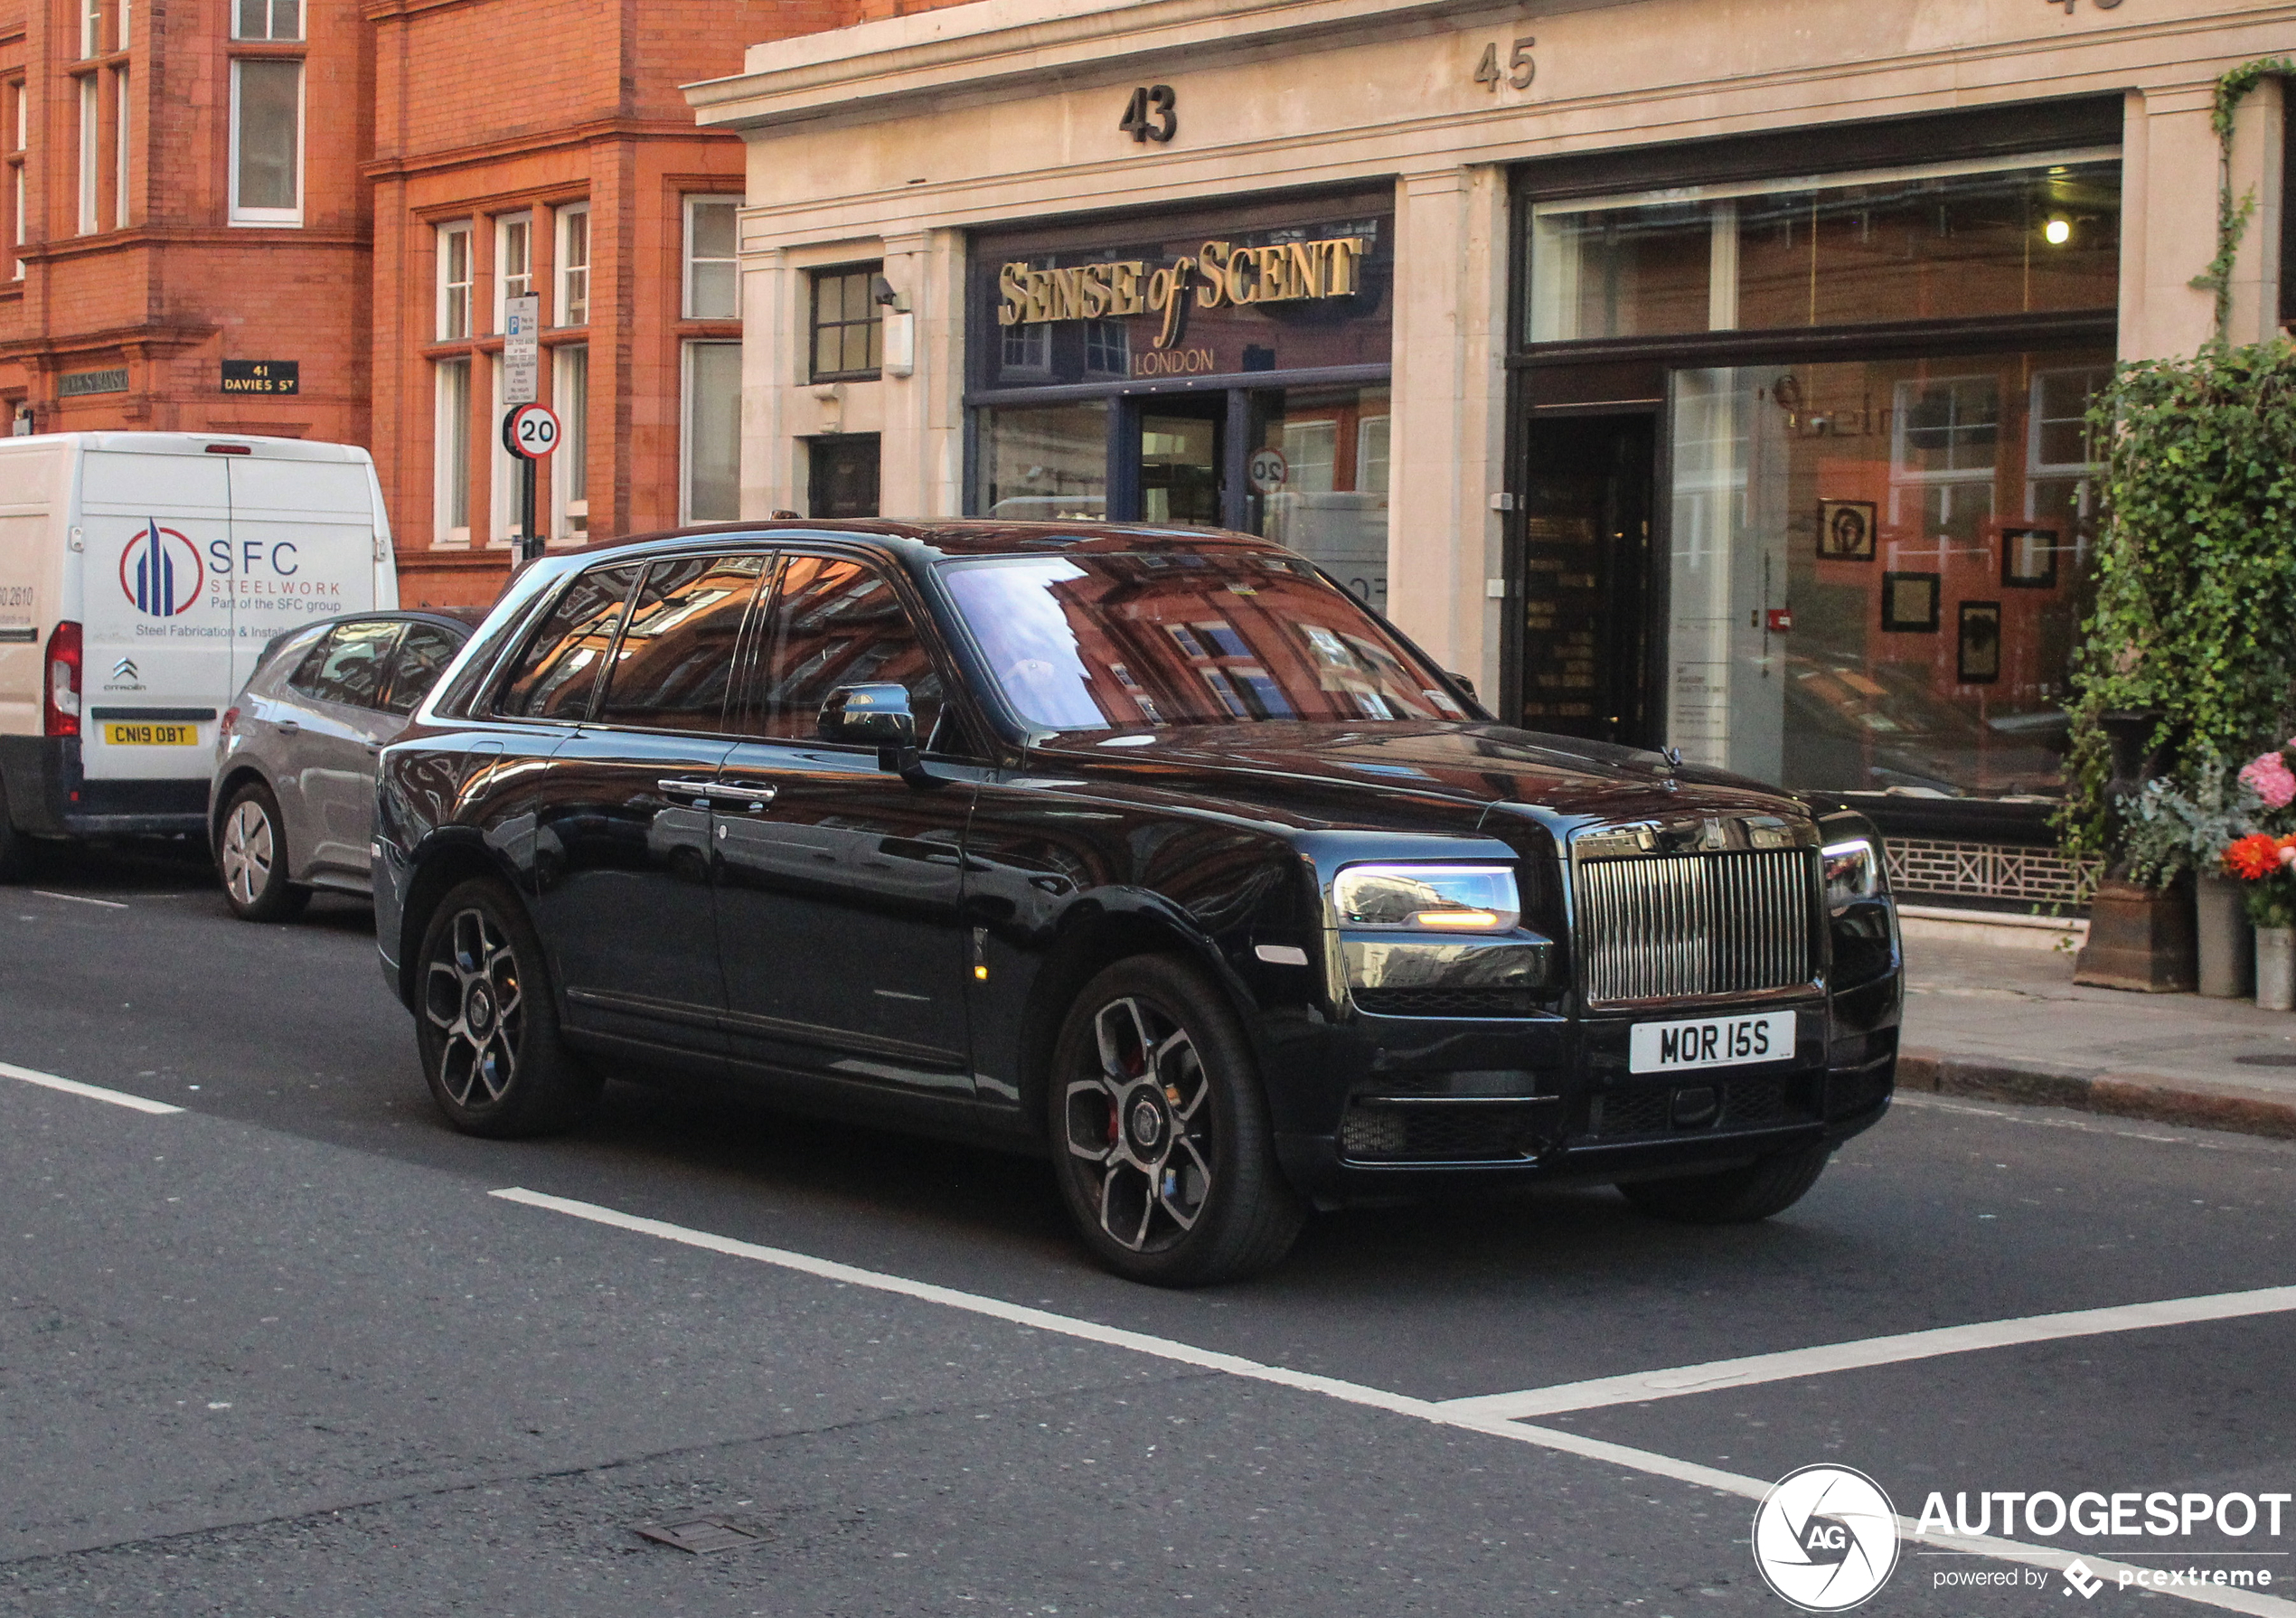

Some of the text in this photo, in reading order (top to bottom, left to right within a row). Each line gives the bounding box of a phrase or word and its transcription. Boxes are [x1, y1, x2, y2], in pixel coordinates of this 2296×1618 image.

[1474, 36, 1536, 92] 45
[1118, 83, 1178, 143] 43
[998, 237, 1364, 349] SENSE of SCENT
[253, 365, 268, 377] 41
[1134, 349, 1214, 376] LONDON
[224, 379, 273, 391] DAVIES
[522, 419, 554, 442] 20
[209, 540, 298, 576] SFC
[10, 587, 33, 606] 2610
[211, 579, 340, 595] STEELWORK
[211, 597, 342, 614] Part of the SFC group
[136, 624, 166, 637] Steel
[170, 625, 235, 638] Fabrication
[240, 626, 248, 637] &
[116, 727, 186, 742] CN19 OBT
[1661, 1020, 1771, 1065] MOR 15S
